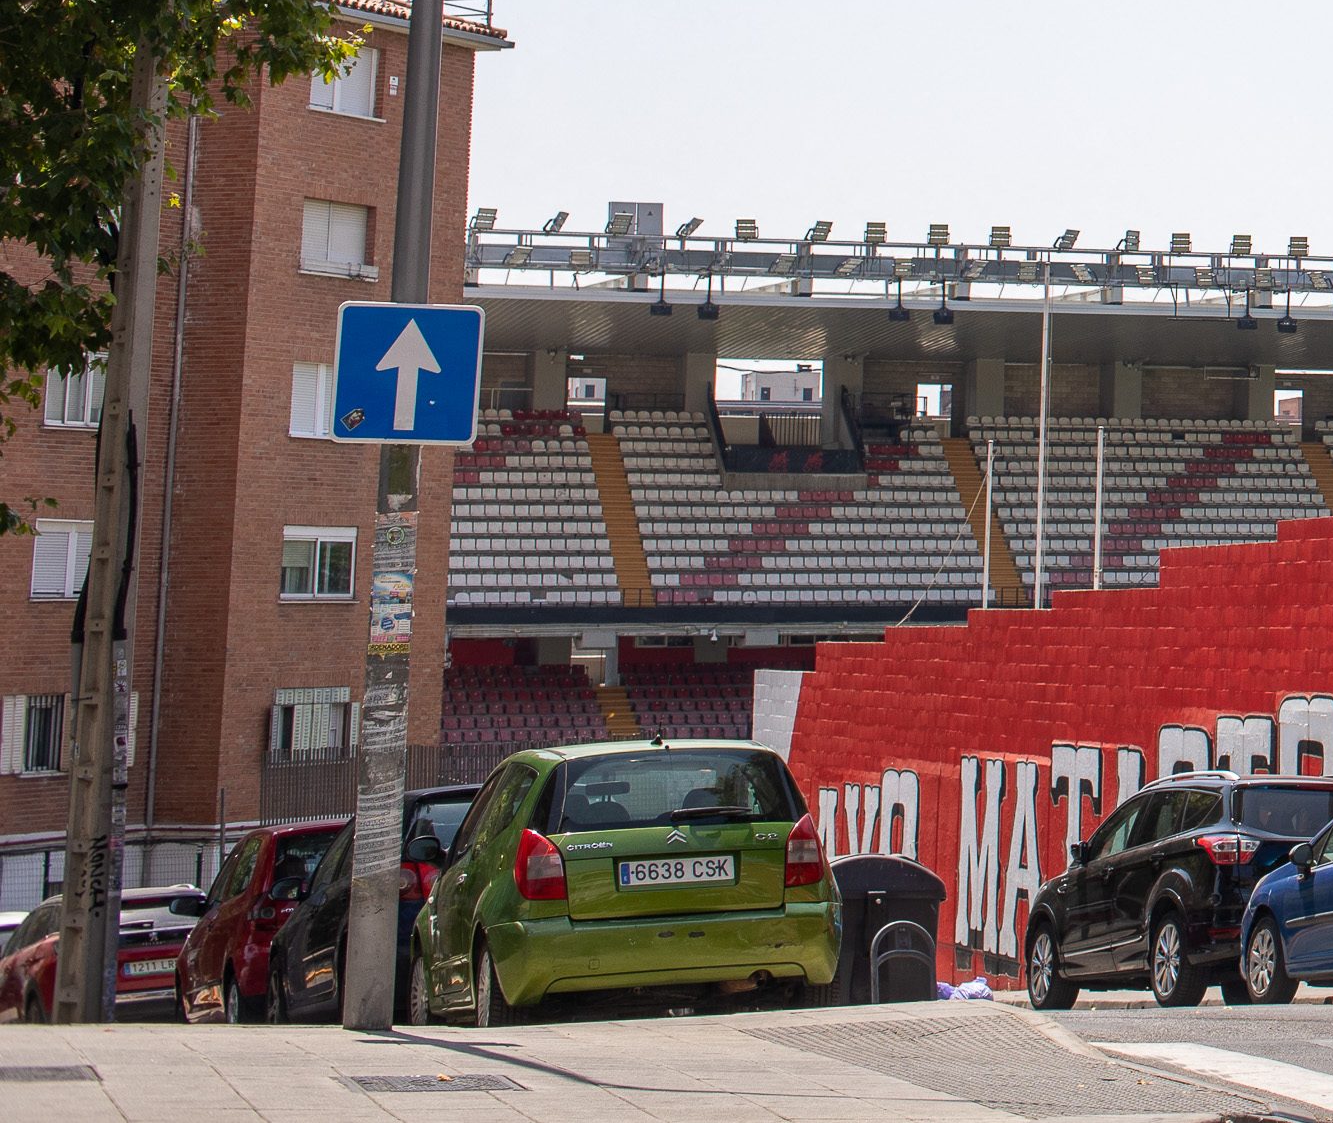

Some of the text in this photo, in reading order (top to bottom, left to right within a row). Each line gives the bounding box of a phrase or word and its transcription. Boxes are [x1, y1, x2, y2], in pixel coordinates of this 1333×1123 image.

[755, 832, 779, 841] C2
[567, 841, 613, 851] CITROËN
[635, 858, 730, 881] 6638 CSK
[132, 959, 177, 973] 1211 LR
